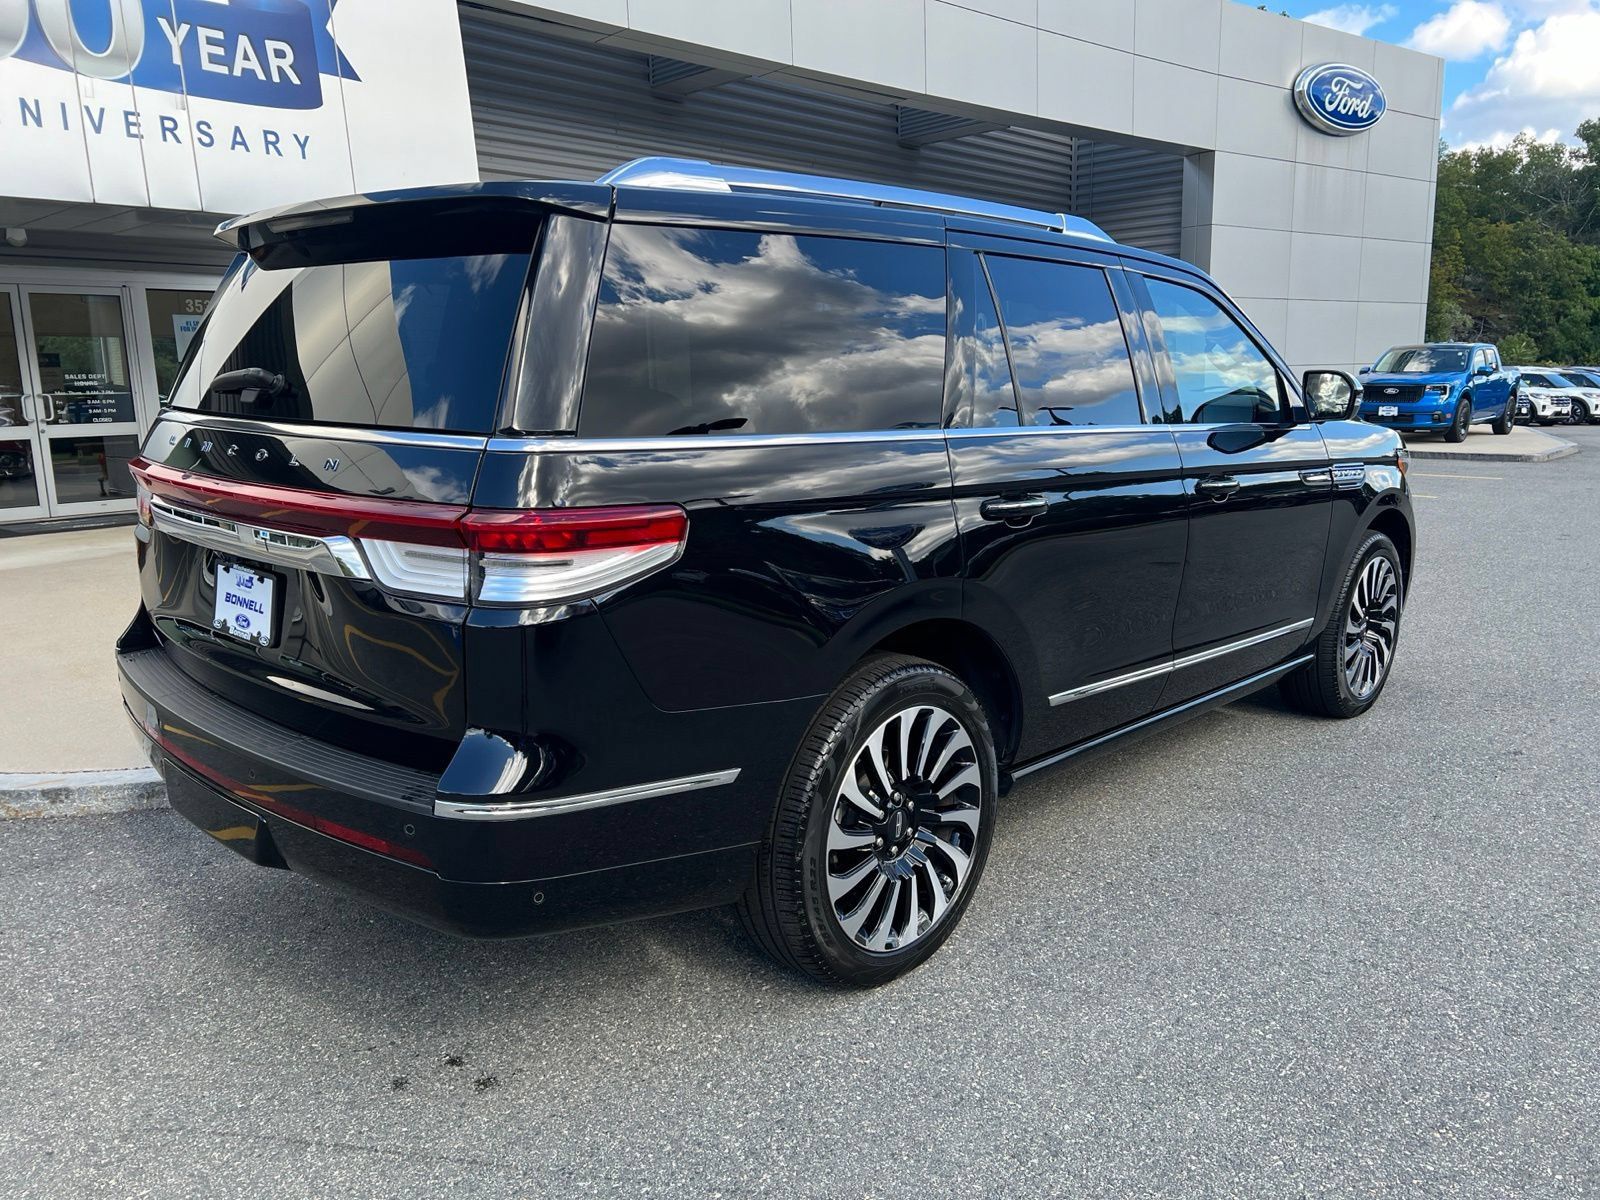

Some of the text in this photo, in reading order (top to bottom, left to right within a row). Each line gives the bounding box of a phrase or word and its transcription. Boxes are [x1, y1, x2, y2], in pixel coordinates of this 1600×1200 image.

[157, 17, 301, 85] YEAR
[1325, 77, 1373, 118] Ford
[19, 97, 310, 160] NIVERSARY
[224, 591, 264, 614] BONNELL
